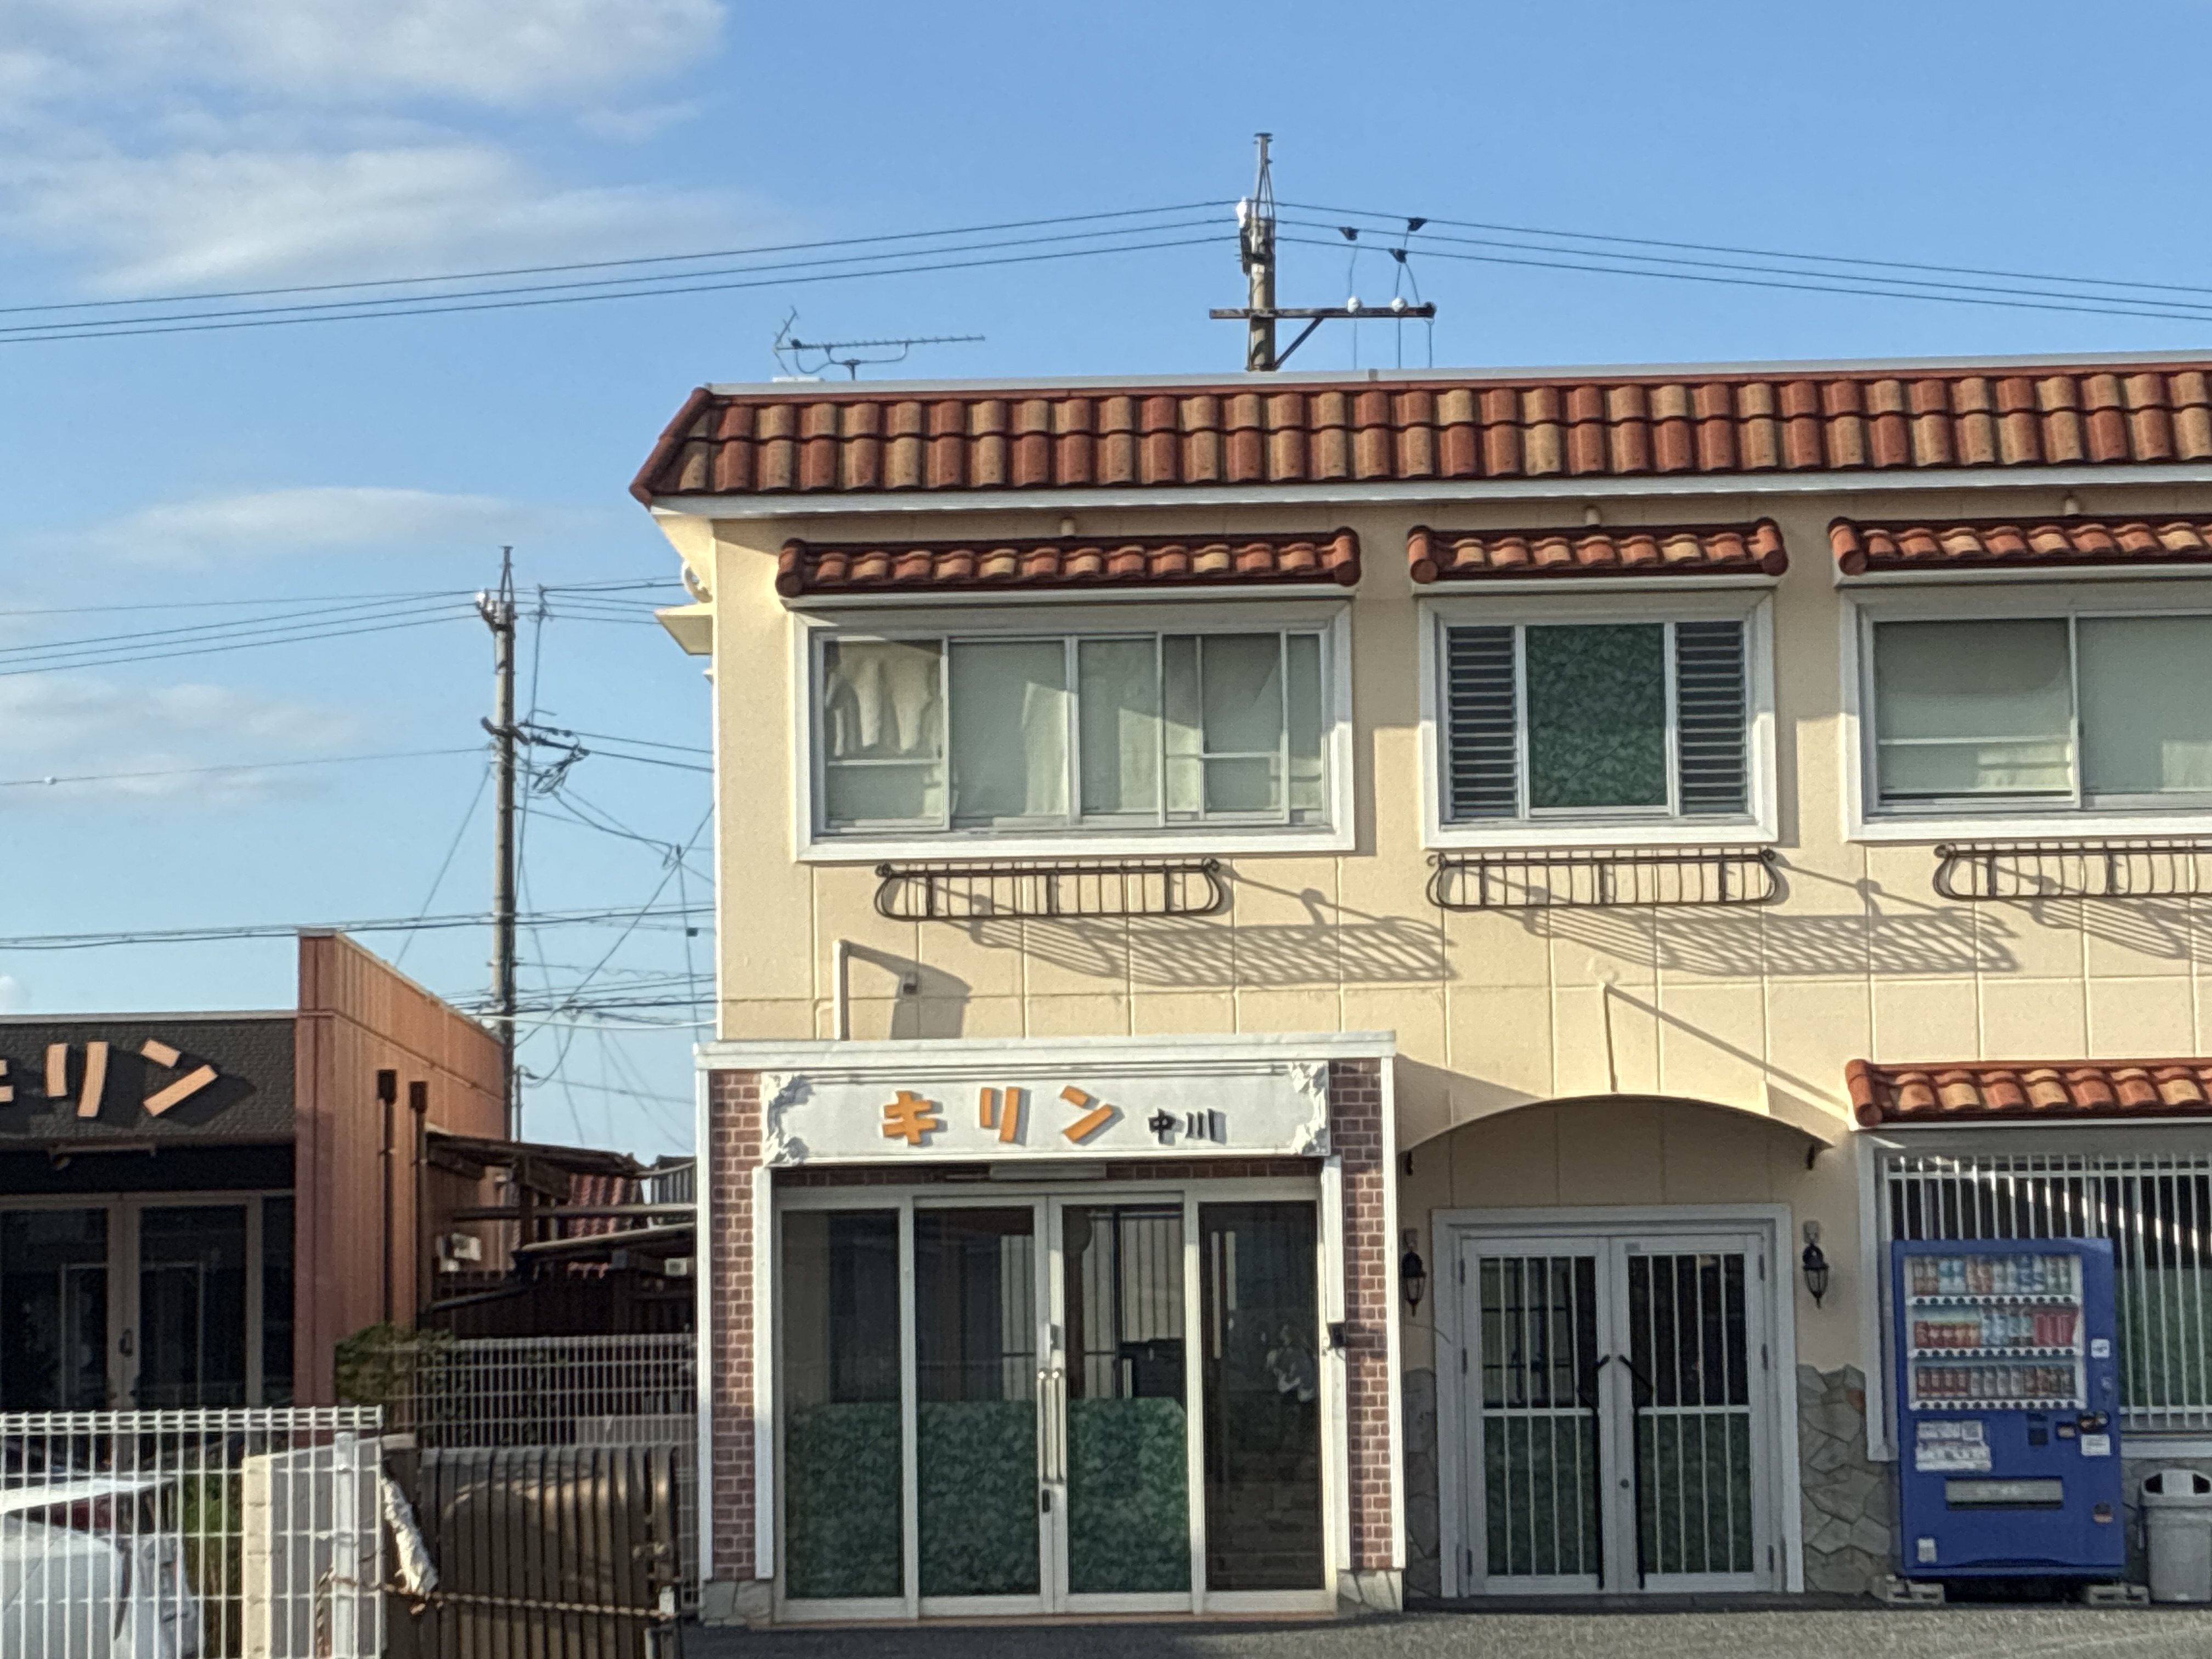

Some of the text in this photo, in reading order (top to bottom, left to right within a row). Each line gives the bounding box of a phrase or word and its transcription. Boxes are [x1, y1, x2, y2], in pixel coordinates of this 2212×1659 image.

[882, 1085, 1219, 1144] キリン 中川
